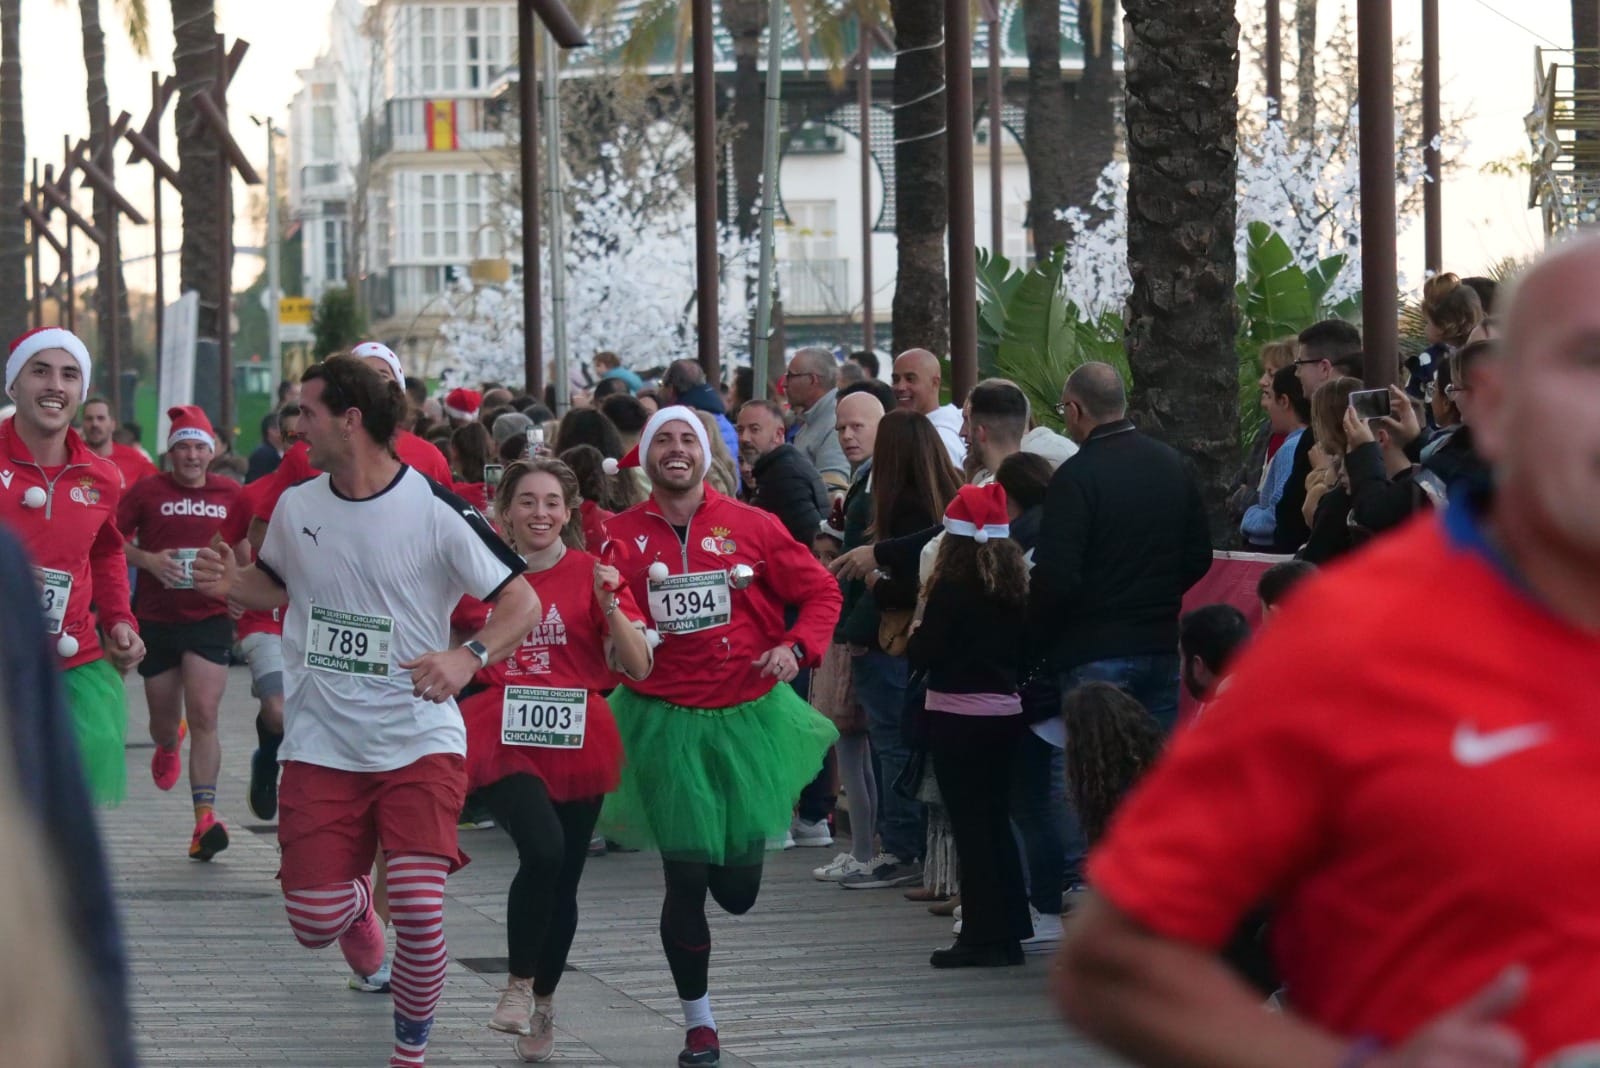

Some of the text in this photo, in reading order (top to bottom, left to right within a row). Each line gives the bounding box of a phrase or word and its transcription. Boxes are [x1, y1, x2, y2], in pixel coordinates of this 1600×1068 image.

[161, 498, 227, 519] adidas
[662, 589, 716, 617] 1394
[326, 610, 352, 621] SILVESTRE
[352, 615, 390, 625] CHICLANERA
[327, 627, 368, 657] 789
[309, 655, 349, 670] CHICLANA
[522, 689, 549, 697] SILVESTRE
[550, 690, 584, 698] CHICLANERA
[518, 703, 571, 730] 1003
[505, 732, 548, 742] CHICLANA
